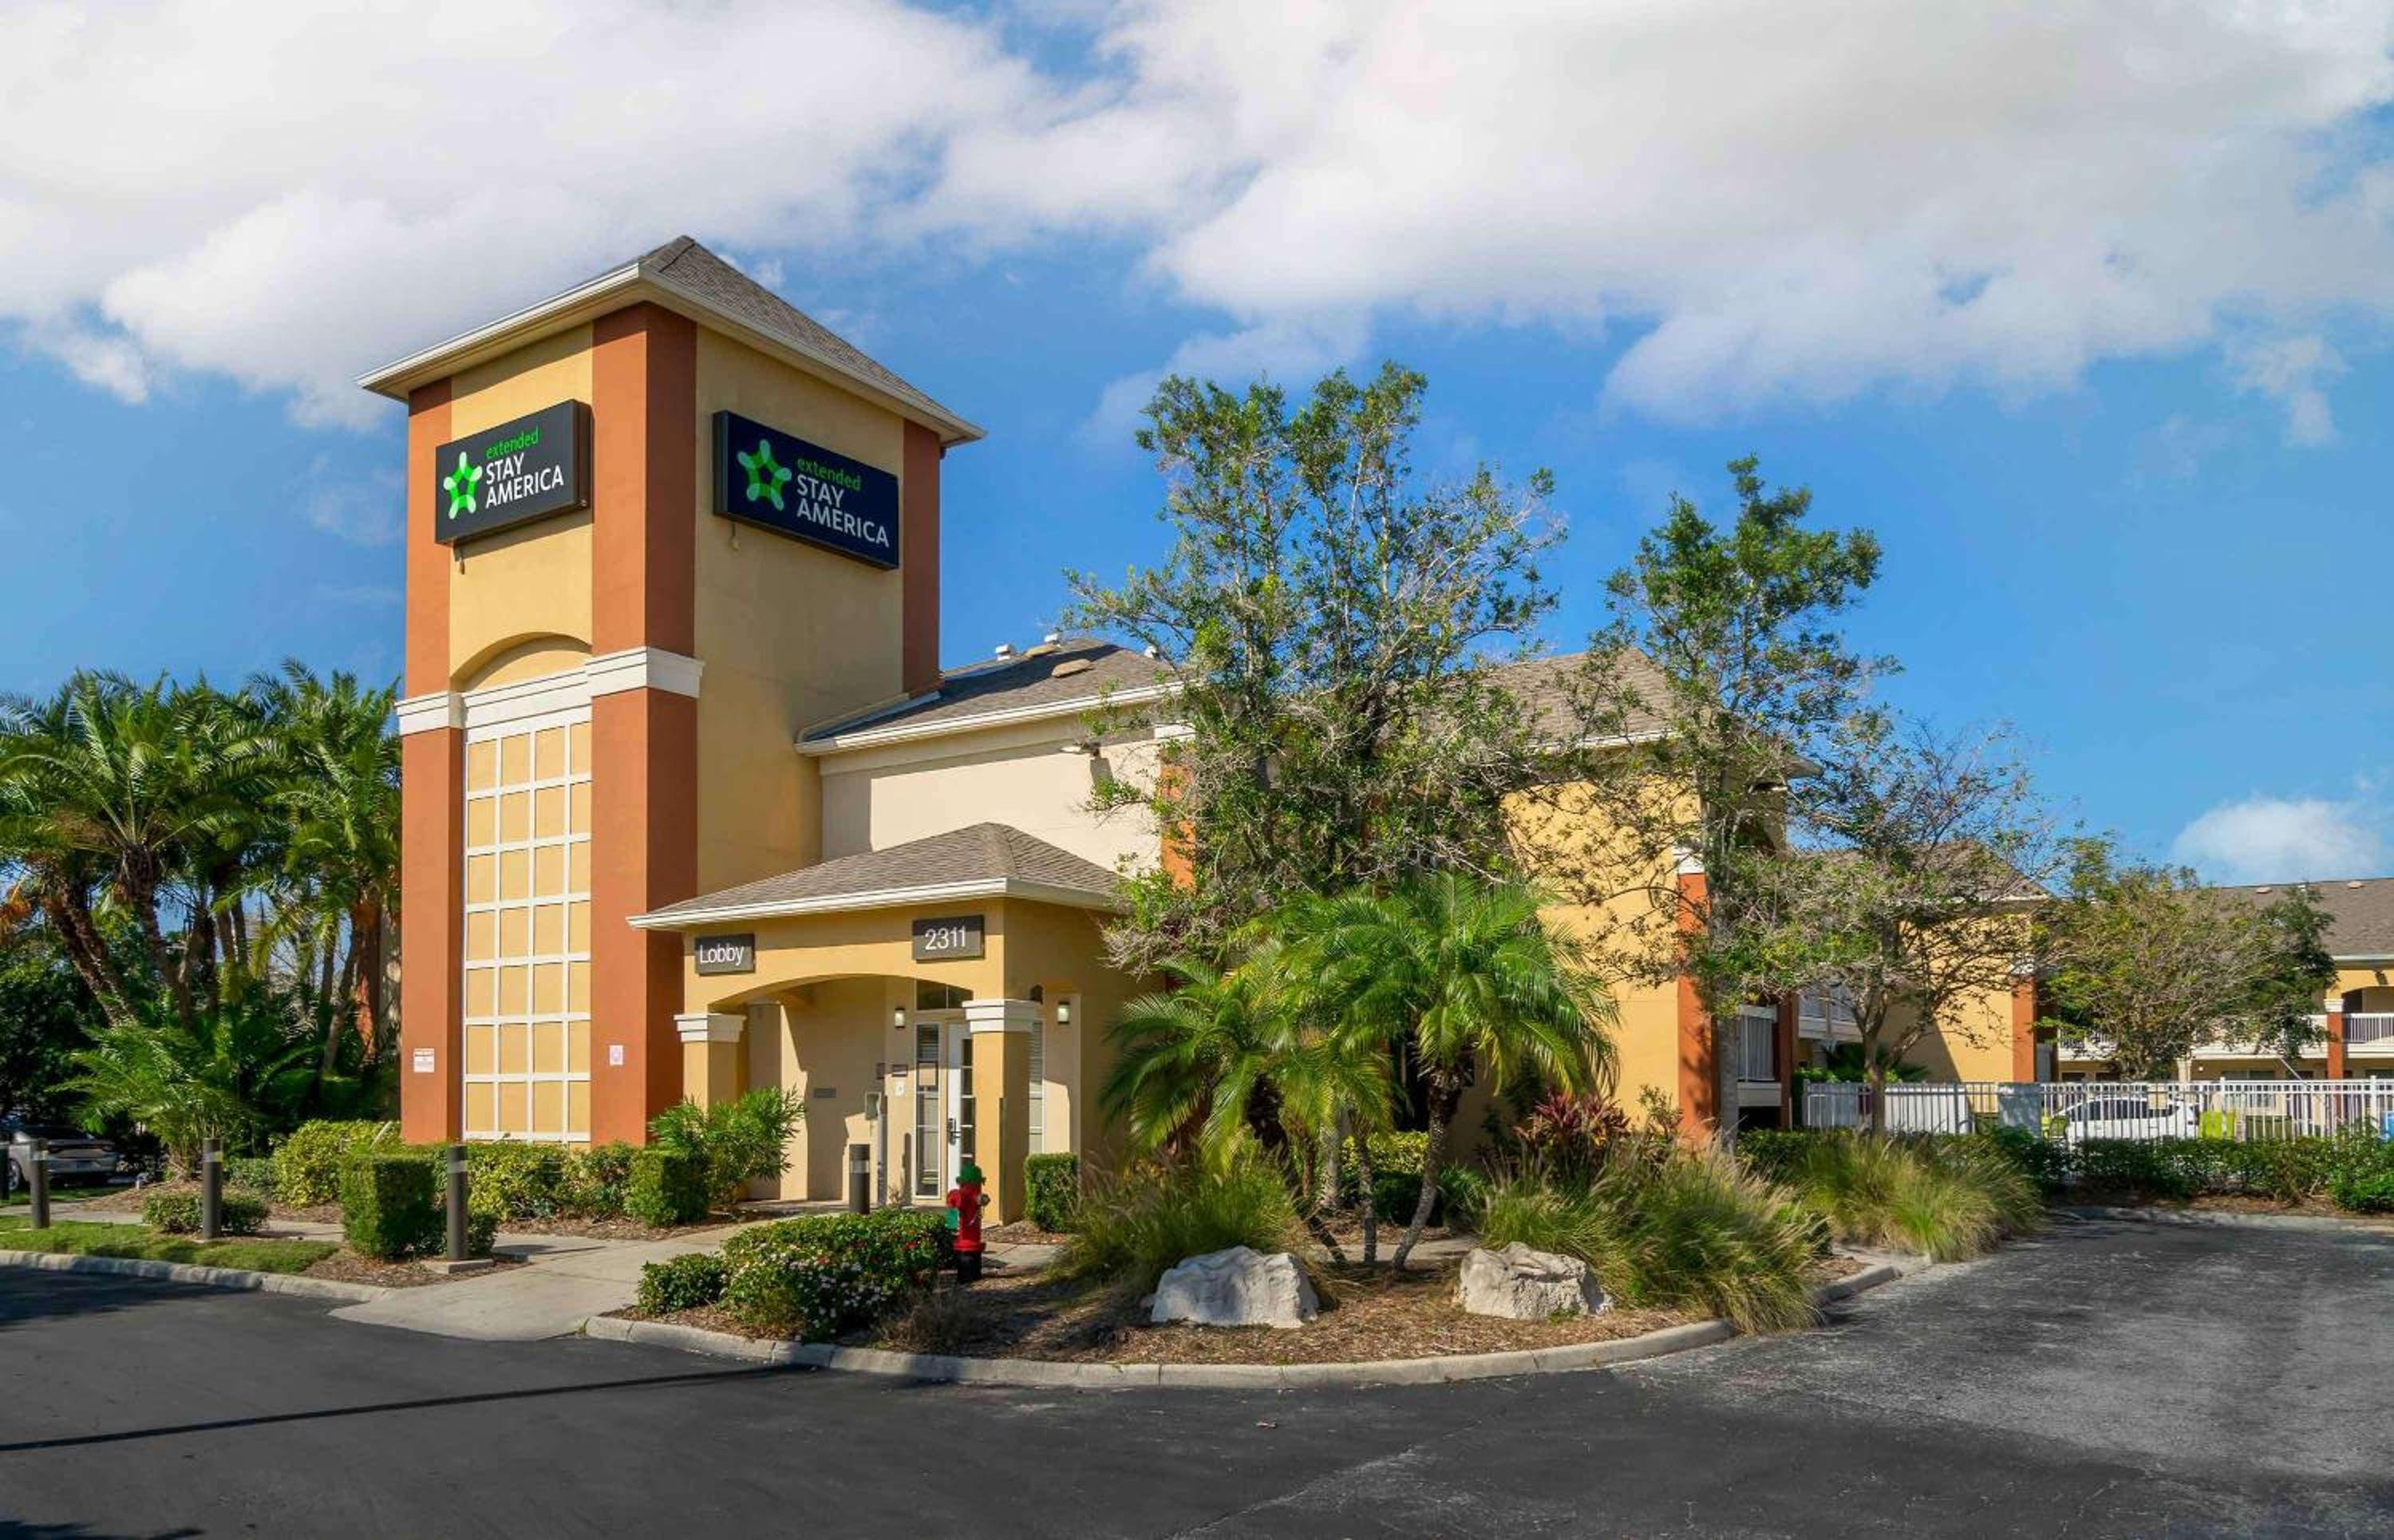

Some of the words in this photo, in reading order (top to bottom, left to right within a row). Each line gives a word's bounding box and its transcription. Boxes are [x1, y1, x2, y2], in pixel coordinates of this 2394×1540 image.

[485, 424, 539, 460] extended
[486, 452, 524, 485] STAY
[797, 457, 861, 492] extended
[485, 464, 564, 508] AMERICA
[797, 475, 844, 507] STAY
[797, 498, 889, 547] AMERICA
[700, 943, 745, 966] Lobby
[925, 926, 966, 950] 2311
